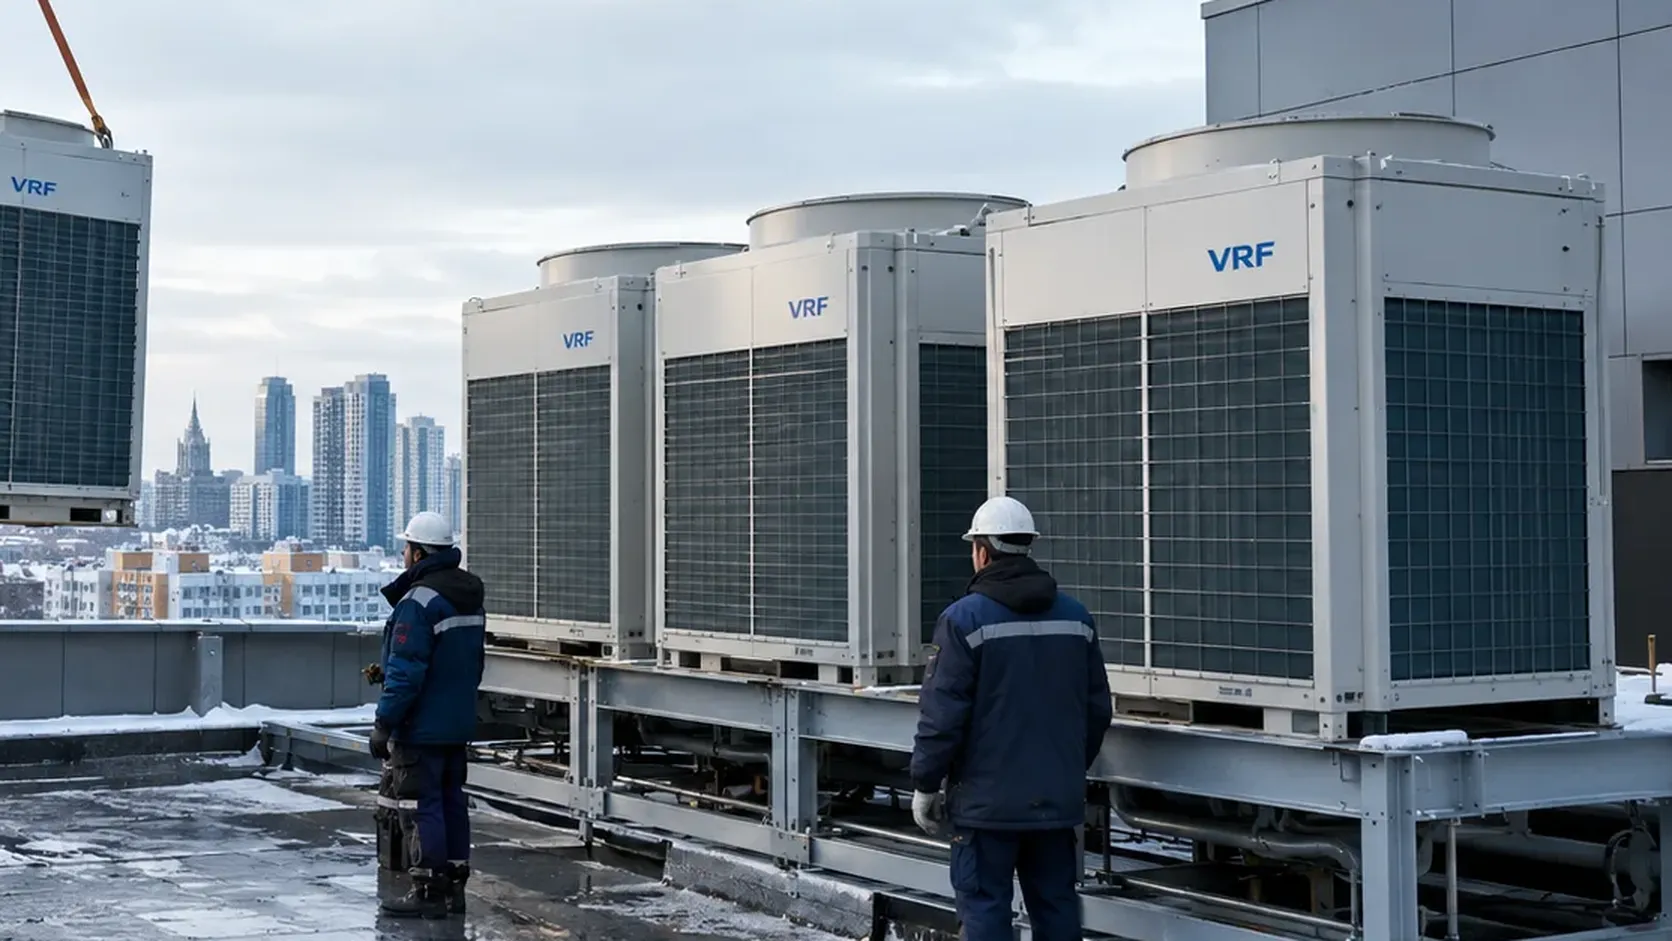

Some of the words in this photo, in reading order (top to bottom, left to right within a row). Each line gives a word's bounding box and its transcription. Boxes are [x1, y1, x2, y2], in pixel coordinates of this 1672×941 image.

[11, 176, 57, 196] VRF
[1207, 241, 1275, 272] VRF
[788, 296, 828, 319] VRF
[563, 330, 594, 349] VRF
